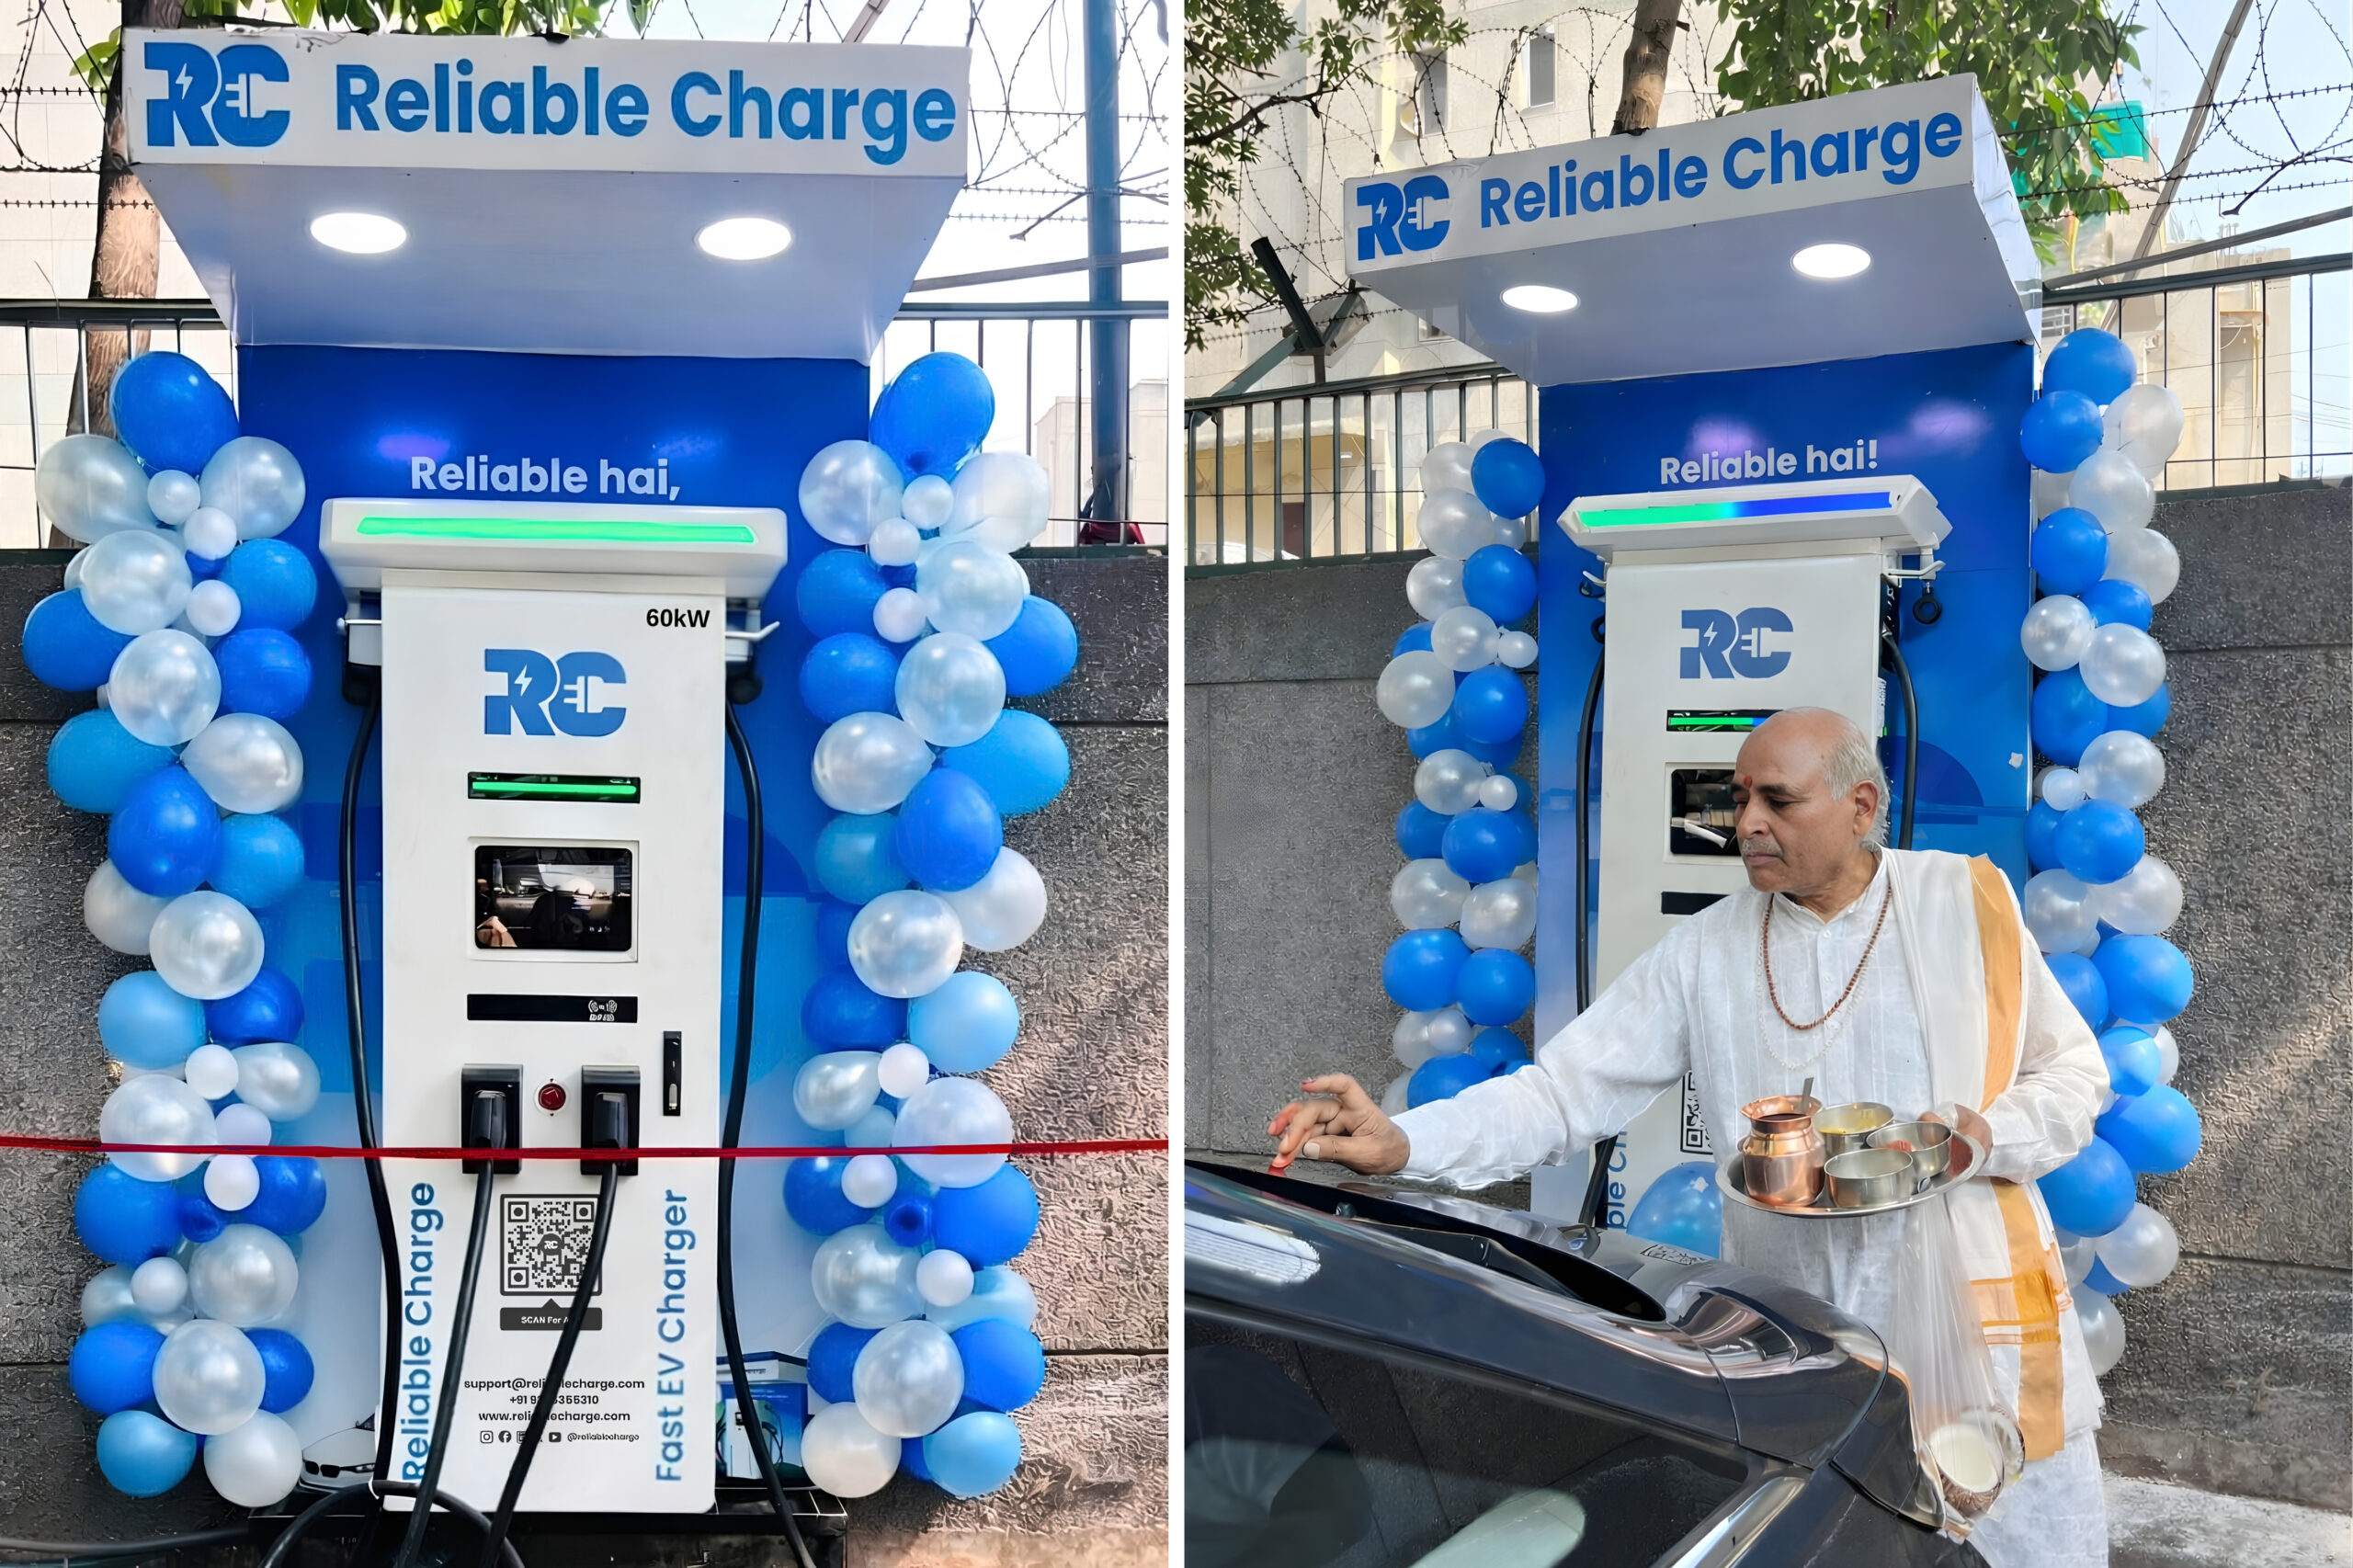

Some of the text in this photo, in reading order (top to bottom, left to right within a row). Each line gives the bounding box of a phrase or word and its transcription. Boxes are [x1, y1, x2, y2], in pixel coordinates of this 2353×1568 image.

[144, 41, 290, 147] RC
[336, 59, 956, 165] Reliable Charge
[1481, 111, 1962, 229] Reliable Charge
[1357, 175, 1449, 260] RC
[411, 454, 680, 501] Reliable hai,
[1661, 439, 1878, 484] Reliable hai!
[646, 608, 710, 628] 60kW
[1679, 607, 1794, 679] RC
[484, 649, 627, 736] RC
[401, 1182, 443, 1481] Reliable Charge
[655, 1189, 696, 1482] Fast EV Charger
[464, 1378, 644, 1392] support@relilecharge.com
[478, 1411, 630, 1424] www.reliecharge.com
[510, 1395, 598, 1404] +91 9355310
